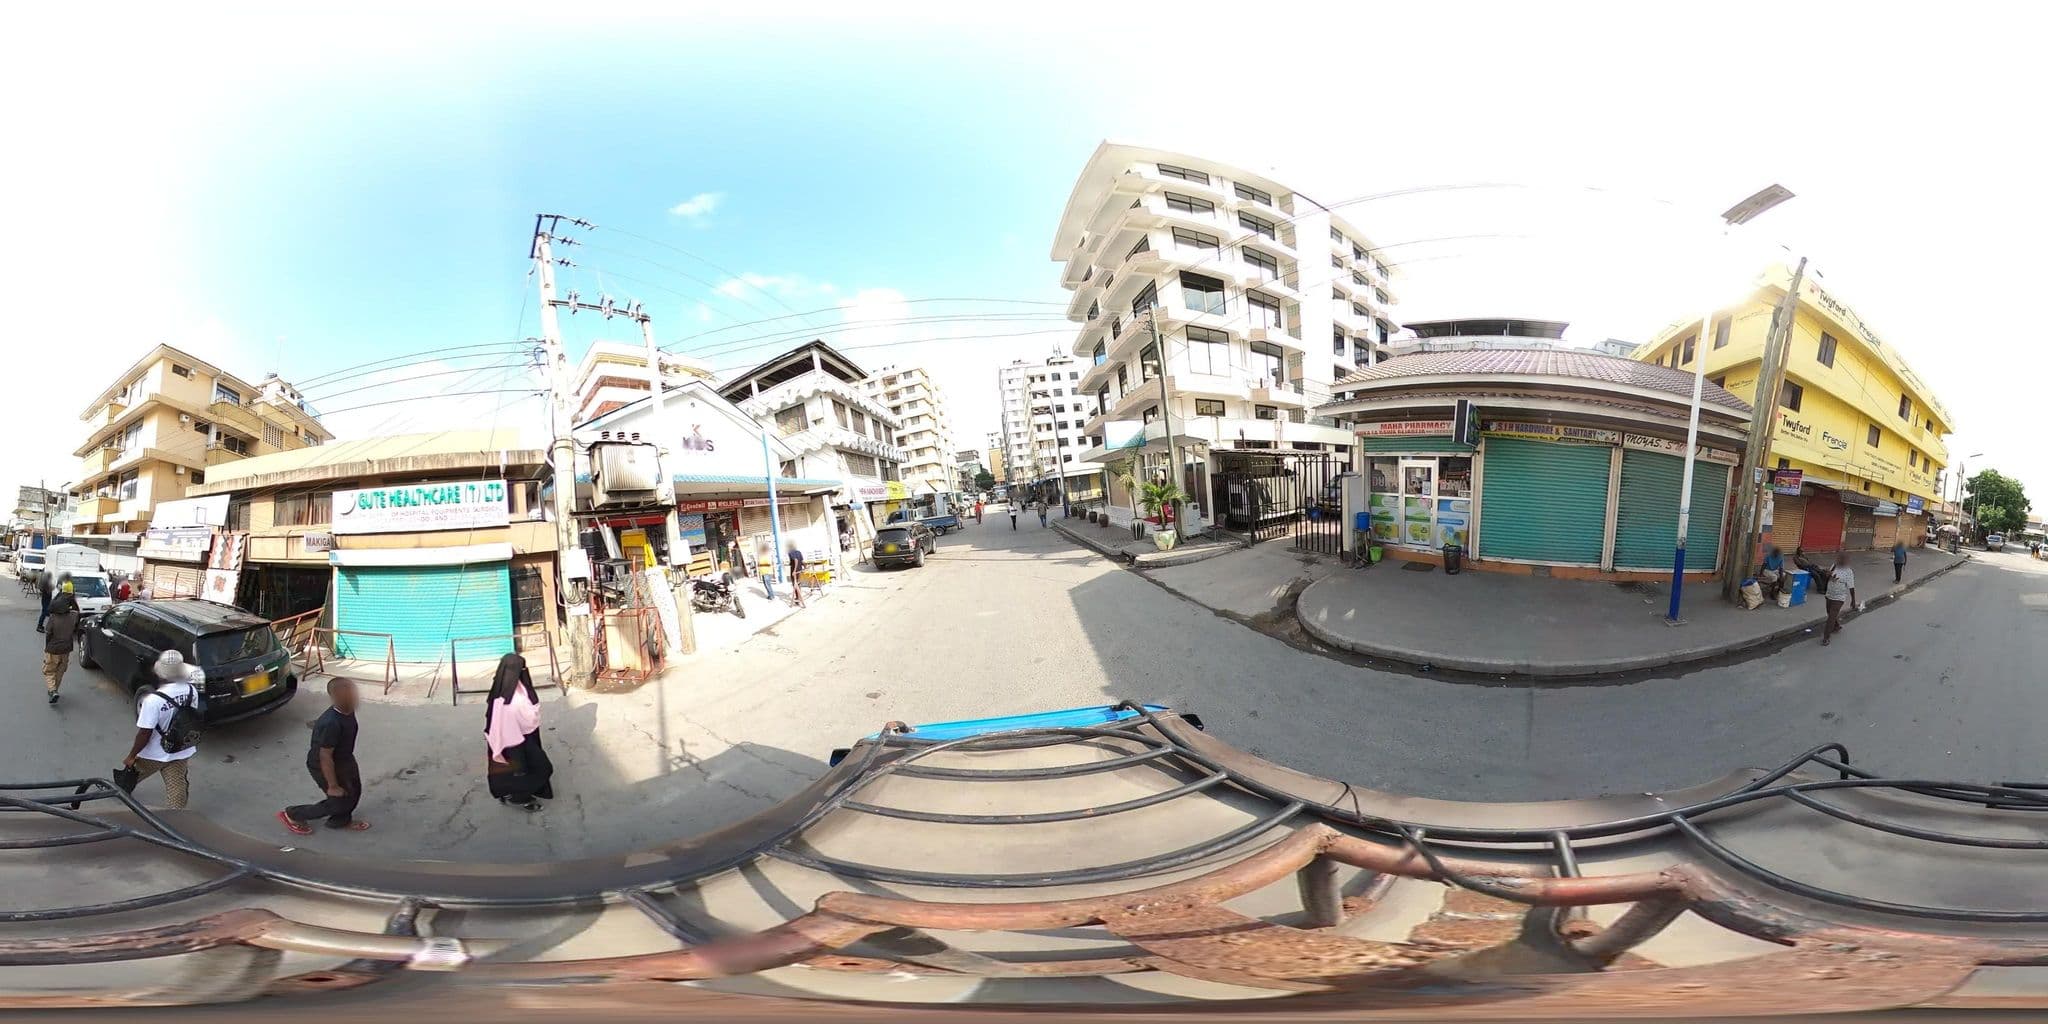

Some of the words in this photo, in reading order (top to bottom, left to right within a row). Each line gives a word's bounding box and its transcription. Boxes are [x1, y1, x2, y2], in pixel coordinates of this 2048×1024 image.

[1819, 288, 1847, 316] Twyford
[1380, 422, 1403, 431] MAHA
[1405, 421, 1452, 430] PHARMACY
[1515, 423, 1553, 434] HARDWARE
[1563, 427, 1596, 438] SANITARY
[1782, 414, 1811, 435] Twyford
[389, 485, 461, 508] HEALTHCARE
[484, 483, 505, 503] LTD
